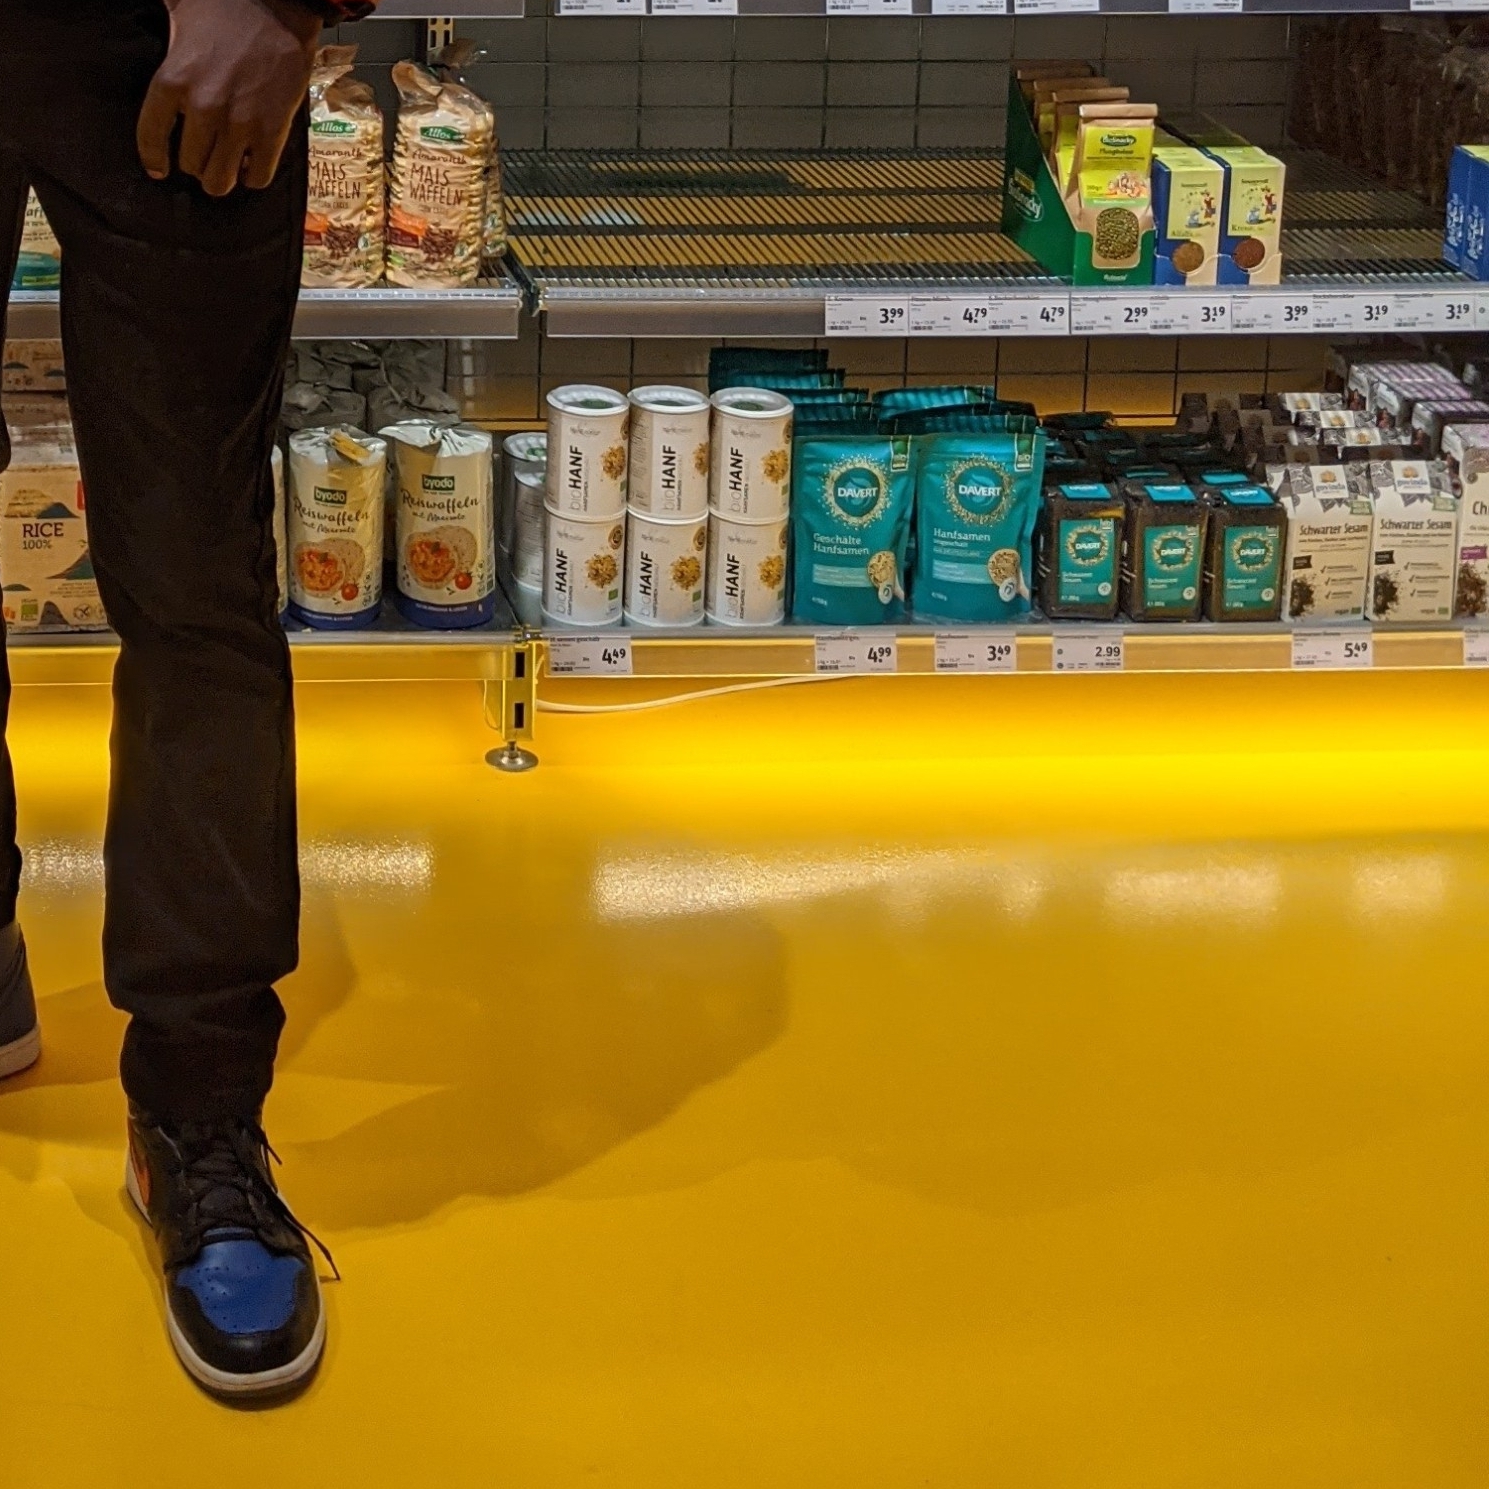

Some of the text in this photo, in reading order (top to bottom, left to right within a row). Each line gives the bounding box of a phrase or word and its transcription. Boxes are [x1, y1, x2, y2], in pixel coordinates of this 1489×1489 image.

[316, 122, 343, 132] Allos
[425, 477, 454, 488] byodo
[838, 487, 878, 498] DAVERT
[959, 485, 1001, 496] DAVERT
[1380, 519, 1451, 530] Schwarzer Sesam
[22, 523, 64, 538] RICE
[934, 528, 990, 541] Hanfsamen
[22, 540, 52, 549] 100%
[813, 533, 861, 545] Geschälte
[813, 545, 869, 555] Hanfsamen
[1095, 647, 1120, 656] 2.99
